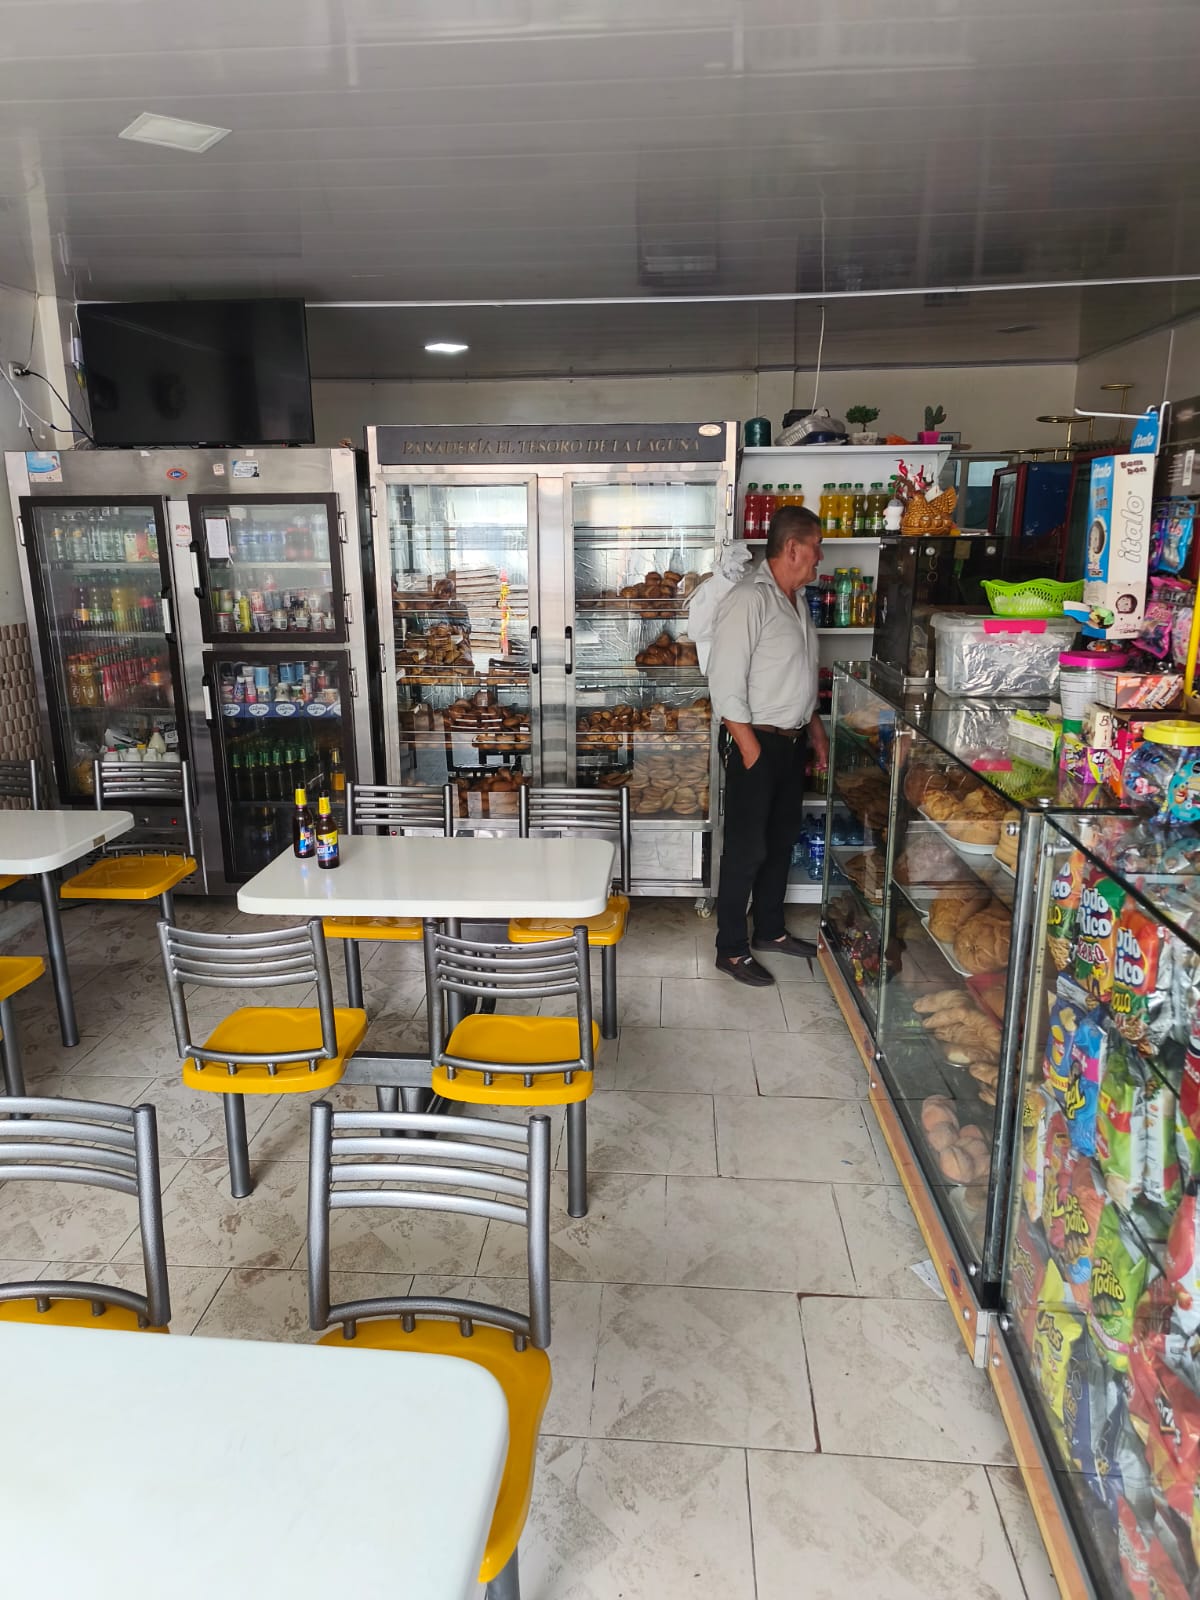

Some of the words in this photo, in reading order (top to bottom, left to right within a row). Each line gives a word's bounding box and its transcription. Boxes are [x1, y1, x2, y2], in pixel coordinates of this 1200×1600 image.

[518, 438, 583, 454] TESORO
[586, 439, 609, 452] DE
[635, 437, 700, 452] LAGUNA
[1117, 495, 1145, 564] italo
[1117, 928, 1141, 958] odo
[1114, 947, 1144, 985] ico
[1064, 1211, 1089, 1236] odito
[1092, 1267, 1126, 1302] Todito
